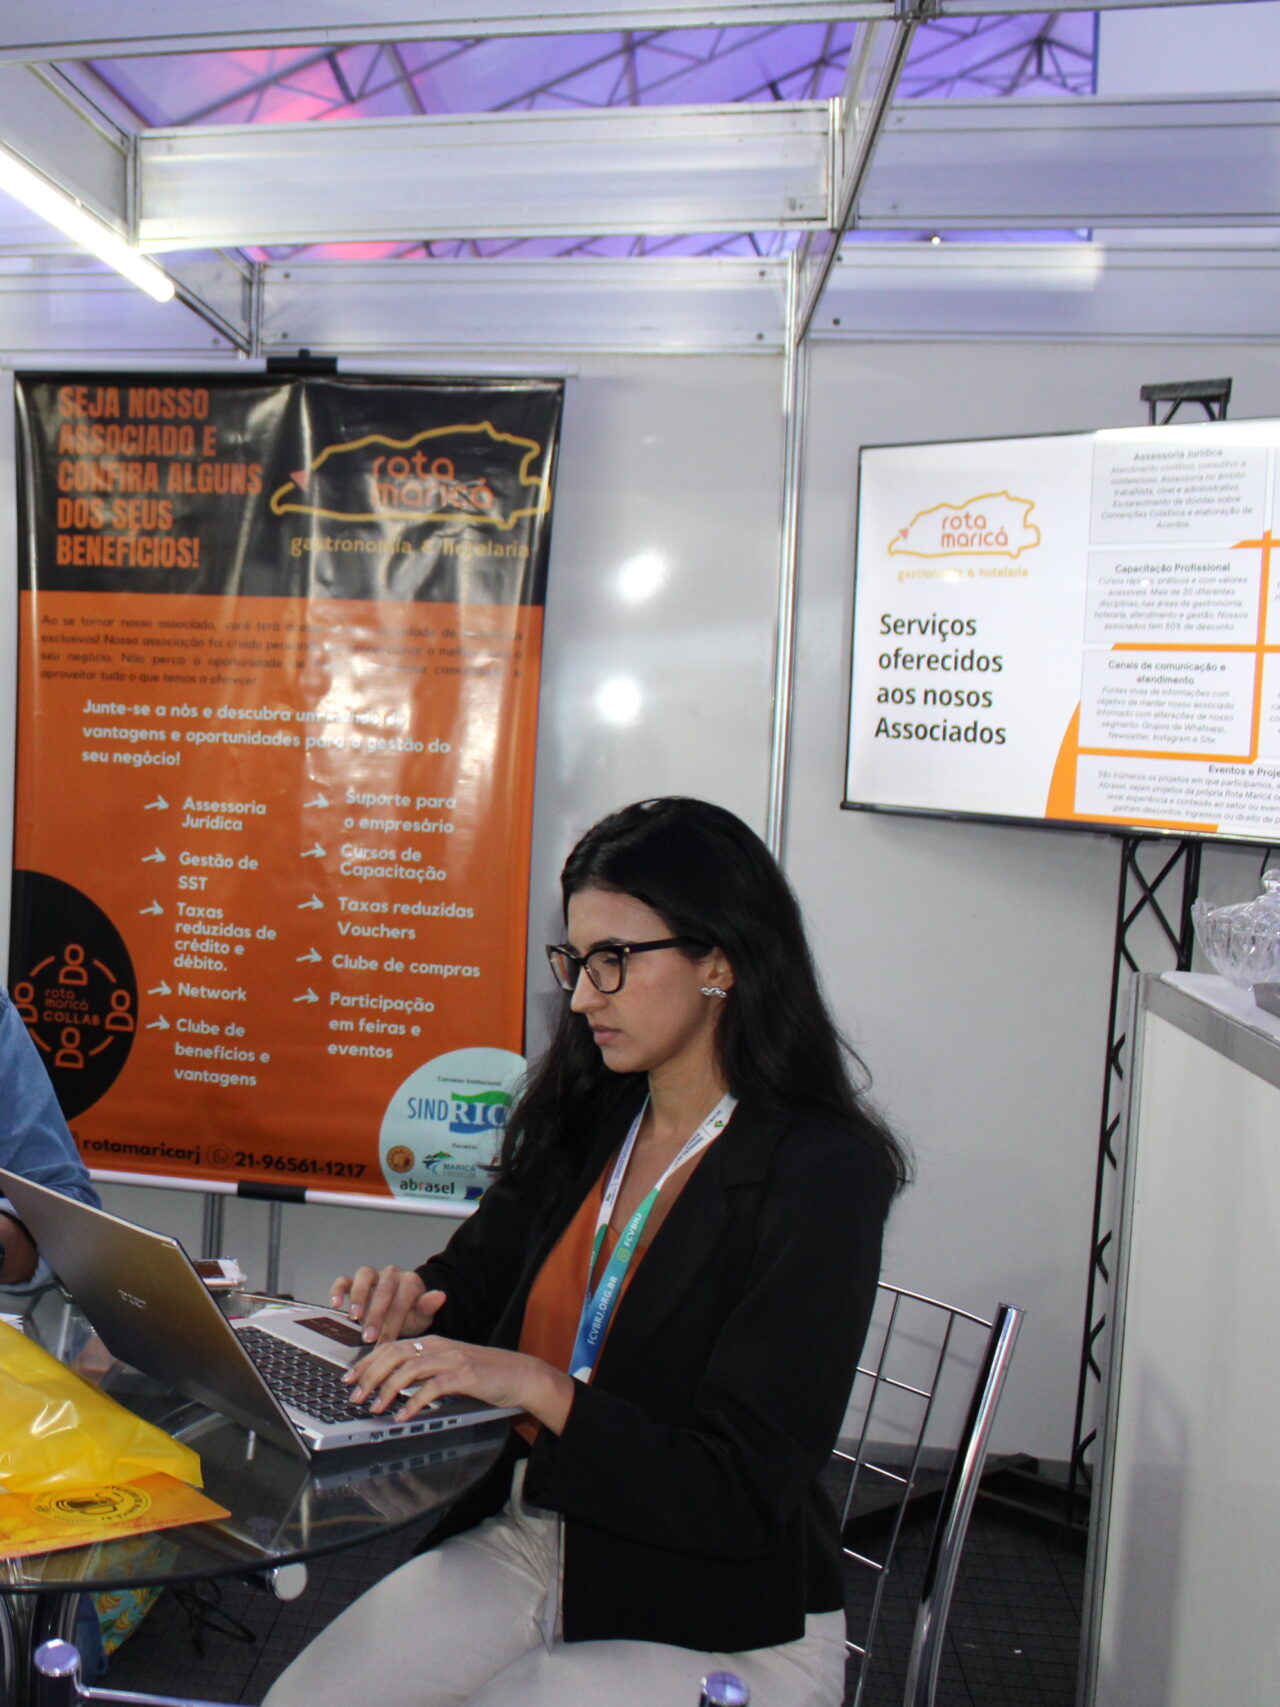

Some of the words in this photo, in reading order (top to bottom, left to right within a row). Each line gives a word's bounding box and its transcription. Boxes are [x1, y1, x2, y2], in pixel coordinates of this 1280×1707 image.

[58, 385, 118, 418] SEJA
[128, 388, 209, 418] NOSSO
[58, 425, 194, 456] ASSOCIADO
[203, 427, 215, 456] E
[373, 451, 455, 480] rota
[1134, 451, 1185, 461] Assessoria
[57, 461, 157, 493] CONFIRA
[166, 464, 262, 495] ALGUNS
[57, 499, 103, 529] DOS
[112, 500, 174, 530] SEUS
[942, 512, 986, 530] rota
[941, 525, 1008, 547] maricá
[57, 530, 200, 568] BENEFÍCIOS!
[980, 566, 1028, 576] hotelaria
[1115, 564, 1171, 575] Capacitação
[1175, 563, 1230, 572] Profissional
[43, 615, 57, 625] Ao
[63, 618, 75, 626] se
[81, 618, 114, 626] tornar
[121, 619, 152, 627] nosso
[880, 613, 977, 642] Serviços
[879, 648, 1003, 673] oferecidos
[1108, 660, 1138, 670] Canais
[1141, 662, 1152, 670] de
[1155, 663, 1217, 672] comunicação
[139, 673, 159, 683] que
[163, 673, 196, 683] temos
[1137, 675, 1194, 685] atendimento
[877, 688, 916, 705] aos
[924, 687, 993, 708] nosos
[83, 701, 151, 718] Junte-se
[155, 707, 167, 717] a
[171, 705, 198, 719] nós
[203, 709, 212, 719] e
[217, 706, 291, 722] descubra
[83, 727, 166, 743] vantagens
[171, 730, 181, 741] e
[186, 730, 300, 747] oportunidades
[305, 736, 345, 750] para
[367, 735, 424, 753] gestão
[428, 738, 451, 753] do
[875, 716, 1007, 745] Associados
[82, 750, 109, 763] seu
[113, 749, 180, 767] negócio!
[1209, 765, 1246, 775] Eventos
[182, 797, 266, 815] Assessoria
[345, 788, 411, 809] Suporte
[415, 795, 456, 812] para
[181, 814, 243, 831] Jurídica
[344, 819, 354, 829] o
[358, 814, 454, 836] empresário
[179, 851, 240, 871] Gestão
[243, 854, 259, 870] de
[340, 843, 402, 862] Cursos
[405, 846, 422, 862] de
[339, 862, 447, 882] Capacitação
[178, 875, 208, 891] SST
[176, 902, 223, 919] Taxas
[338, 896, 388, 915] Taxas
[392, 899, 474, 919] reduzidas
[175, 921, 252, 939] reduzidas
[256, 925, 276, 940] de
[337, 921, 416, 940] Vouchers
[175, 937, 230, 954] crédito
[234, 943, 245, 955] e
[174, 954, 227, 973] débito.
[332, 954, 379, 971] Clube
[384, 957, 405, 973] de
[409, 962, 481, 978] compras
[178, 983, 247, 1001] Network
[330, 992, 435, 1014] Participação
[43, 1011, 100, 1026] COLLAB
[176, 1018, 222, 1036] Clube
[225, 1022, 245, 1037] de
[329, 1019, 355, 1032] em
[358, 1017, 405, 1035] feiras
[410, 1023, 422, 1036] e
[174, 1042, 257, 1063] benefícios
[260, 1050, 271, 1063] e
[327, 1042, 394, 1059] eventos
[174, 1067, 257, 1088] vantagens
[83, 1139, 201, 1164] rotamaricarj
[235, 1151, 367, 1178] 21-96561-1217
[400, 1178, 455, 1194] abrasel
[624, 1212, 643, 1248] FCVBRJ
[587, 1275, 618, 1345] FCVBRJ.ORG.BR
